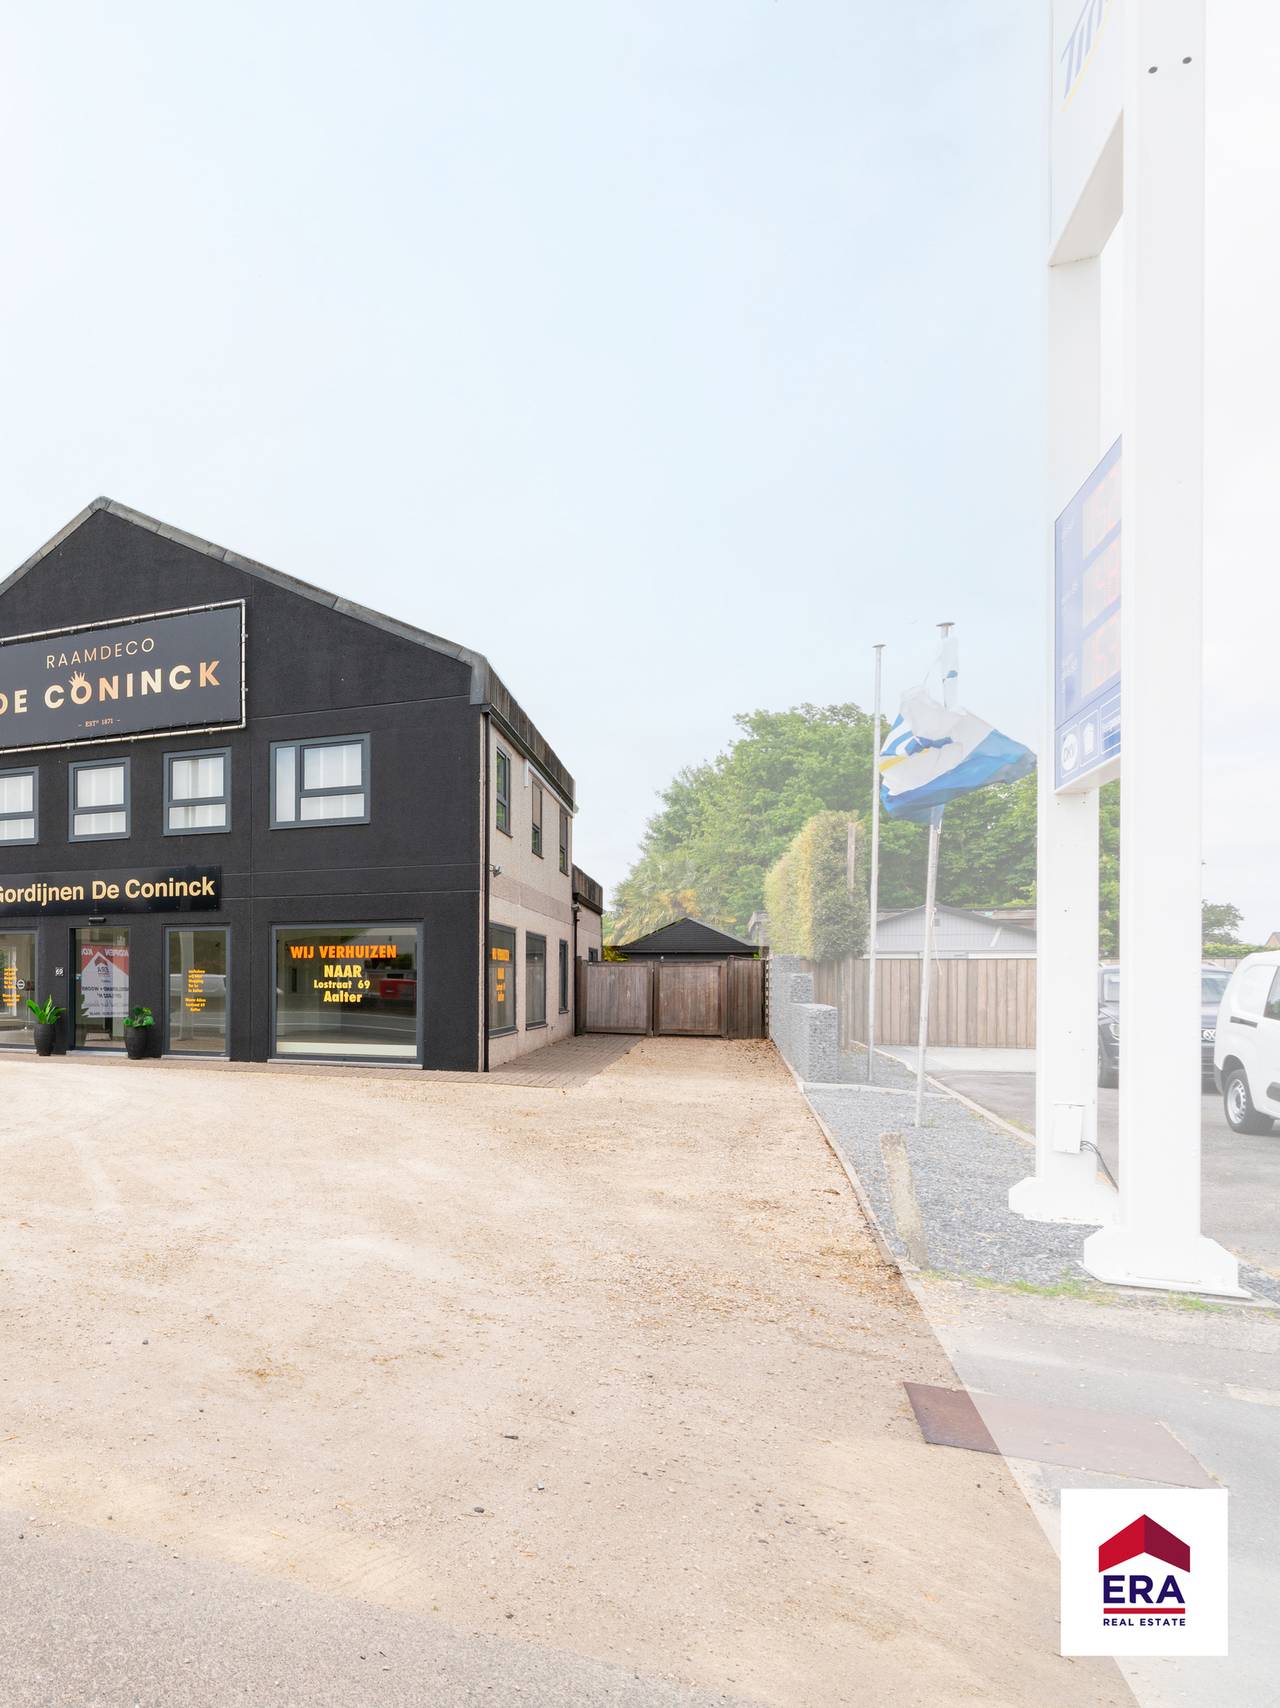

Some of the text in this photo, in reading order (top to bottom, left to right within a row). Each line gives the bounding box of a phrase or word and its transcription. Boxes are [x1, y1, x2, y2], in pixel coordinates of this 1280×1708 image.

[46, 637, 155, 669] RAAMDECO
[44, 660, 221, 709] CONINCK
[91, 880, 119, 900] De
[124, 876, 216, 899] Coninck
[290, 944, 397, 959] WIJ VERHUIZEN
[323, 964, 362, 978] NAAR
[313, 979, 371, 989] Lostraat 69
[323, 990, 363, 1003] Aalter
